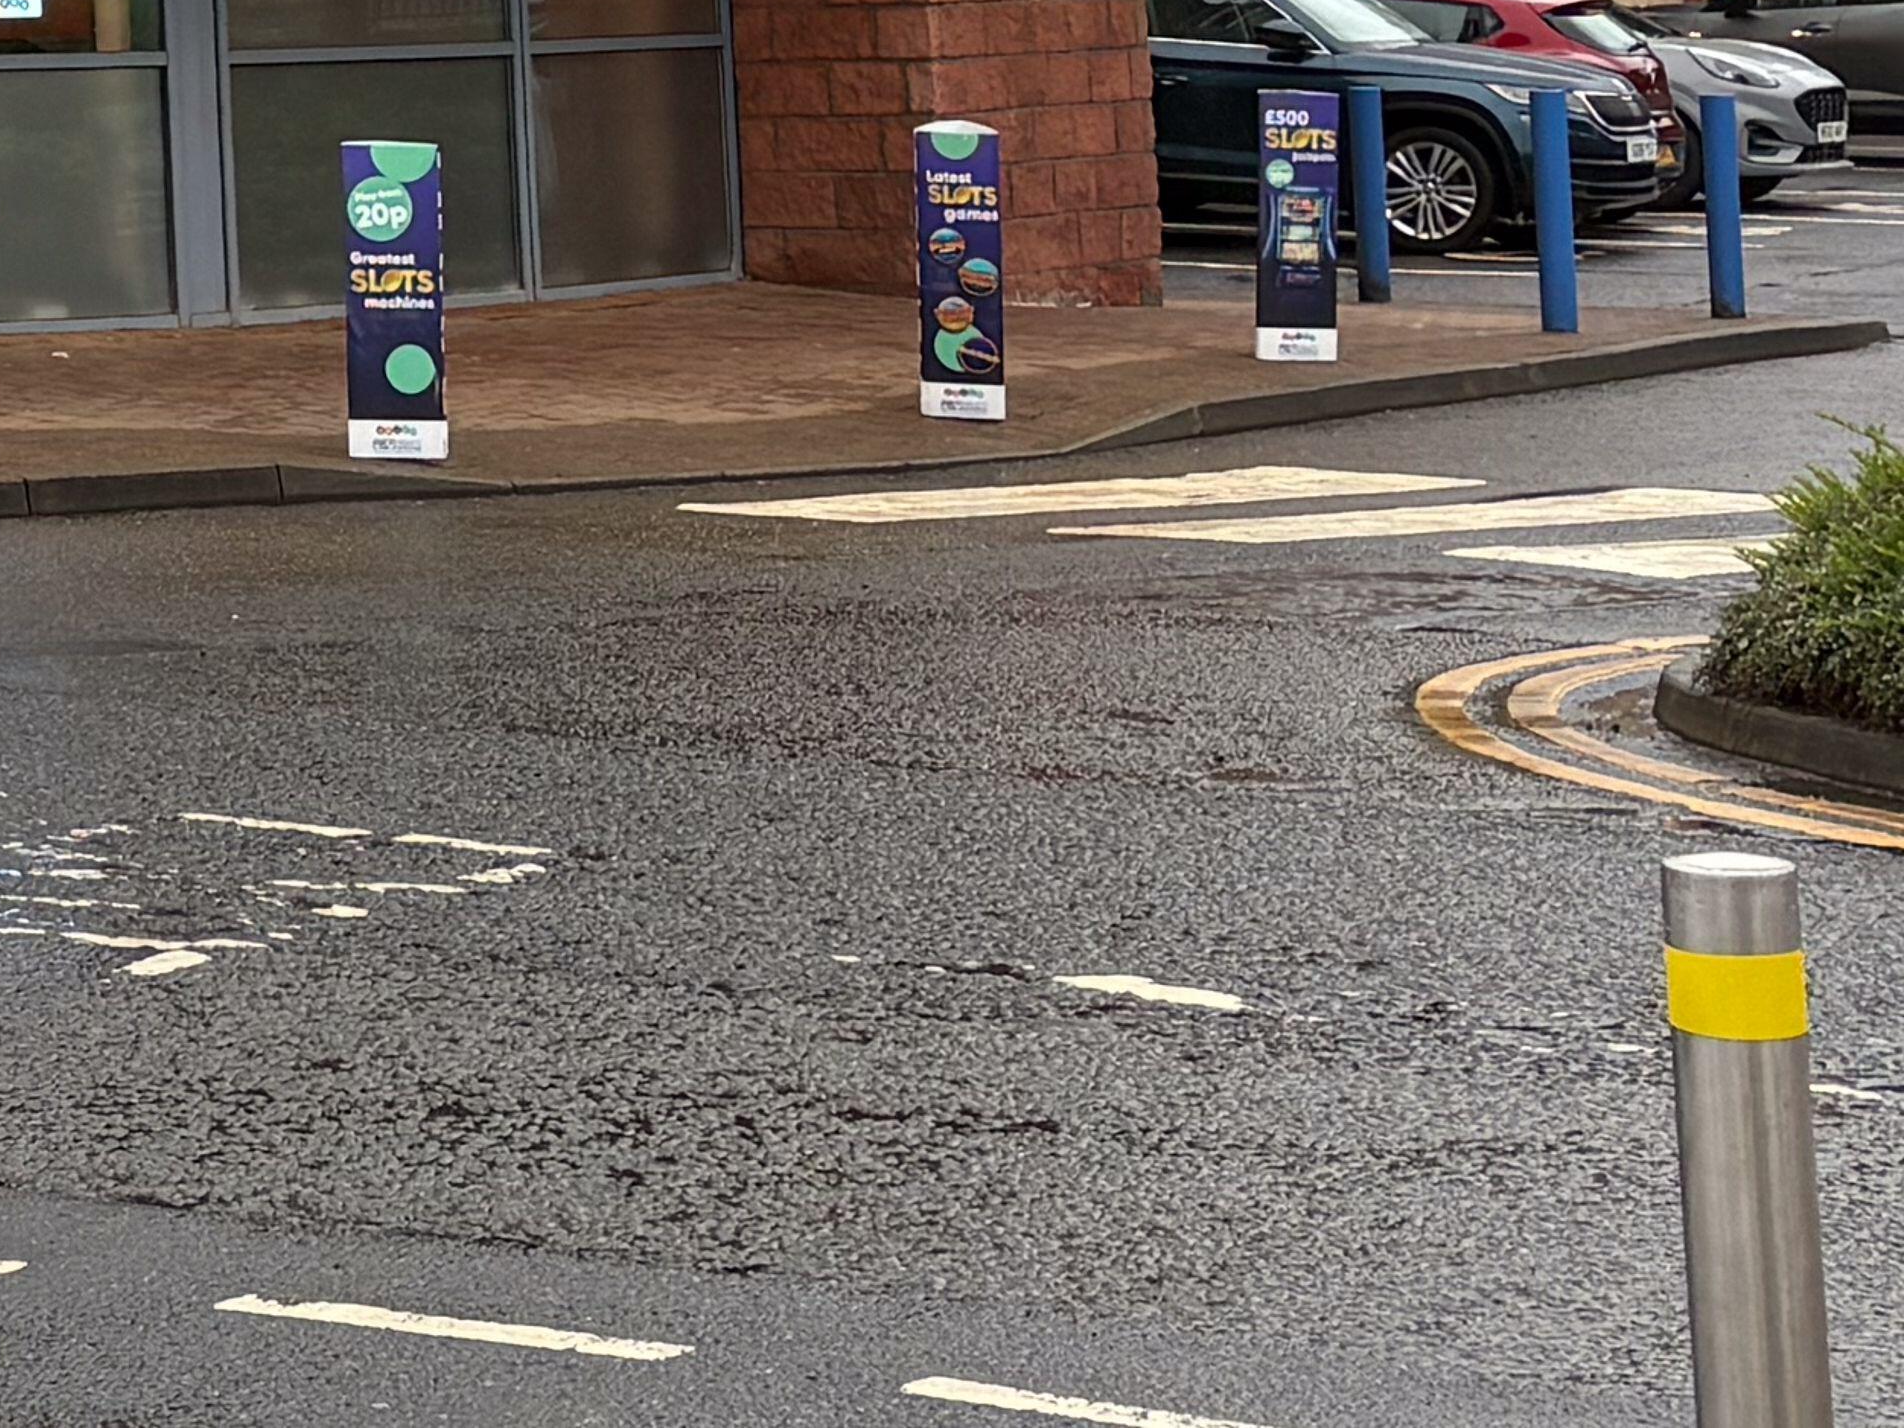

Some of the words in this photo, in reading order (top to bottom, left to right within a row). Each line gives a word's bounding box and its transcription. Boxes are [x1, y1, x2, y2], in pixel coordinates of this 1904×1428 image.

[1265, 109, 1310, 126] £500
[1264, 127, 1337, 150] SLOTS
[925, 169, 972, 184] Latest
[927, 183, 997, 206] SLOTS
[354, 202, 408, 230] 20p
[943, 208, 999, 224] games
[349, 250, 416, 266] Greatest
[350, 268, 435, 294] SLOTS
[363, 295, 435, 310] machines
